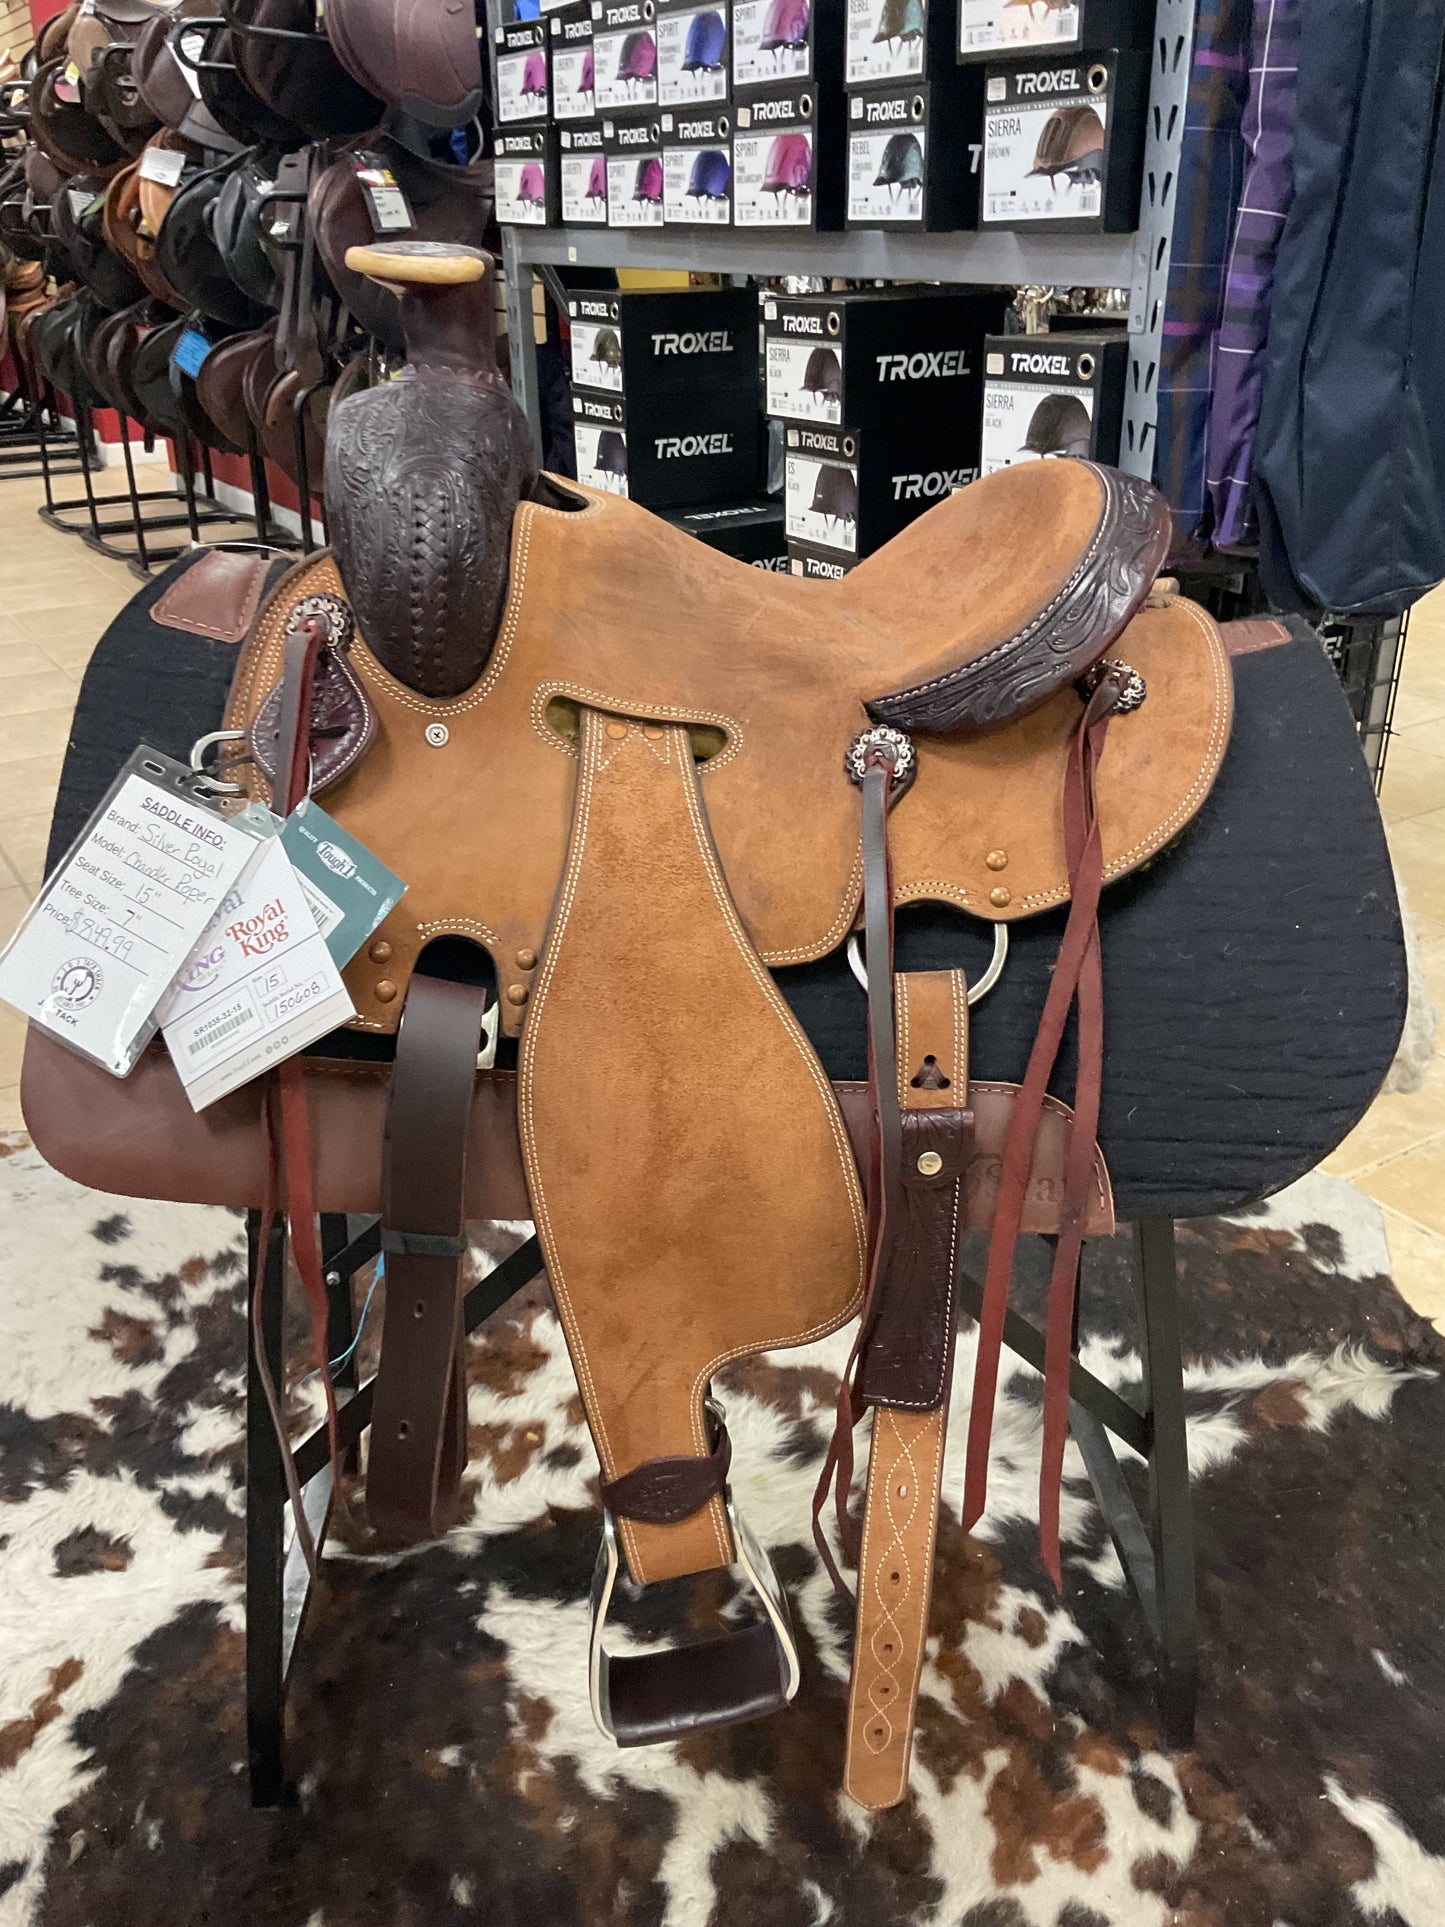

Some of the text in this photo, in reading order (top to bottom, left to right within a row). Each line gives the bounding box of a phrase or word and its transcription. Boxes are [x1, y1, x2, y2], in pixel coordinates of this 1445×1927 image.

[607, 5, 640, 26] TROXEL
[507, 31, 534, 47] TROXEL
[564, 21, 593, 39] TROXEL
[1015, 69, 1081, 95] TROXEL
[752, 101, 796, 120] TROXEL
[866, 100, 907, 122] TROXEL
[618, 128, 649, 144] TROXEL
[678, 121, 715, 139] TROXEL
[988, 117, 1022, 138] SIERRA
[505, 137, 533, 151] TROXEL
[573, 132, 602, 147] TROXEL
[987, 146, 1010, 160] BROWN
[581, 302, 608, 317] TROXEL
[782, 315, 824, 334] TROXEL
[651, 331, 734, 356] TROXEL
[769, 347, 791, 363] SIERRA
[1011, 353, 1070, 375] TROXEL
[876, 350, 971, 382] TROXEL
[584, 402, 613, 420] TROXEL
[986, 394, 1014, 411] SIERRA
[655, 433, 733, 459] TROXEL
[801, 431, 839, 452] TROXEL
[142, 797, 226, 850] SADDLE INFO:
[107, 809, 224, 880] Brand: Silver Royal
[75, 856, 98, 876] Seat
[100, 870, 127, 892] Size:
[90, 833, 124, 858] Model:
[175, 873, 216, 905] Roper
[60, 879, 83, 899] Tree
[83, 893, 111, 915] Size:
[42, 902, 73, 926] Price:
[225, 898, 286, 941] Royal
[239, 920, 289, 958] King
[265, 973, 280, 993] 15
[274, 981, 320, 1019] 150608
[55, 1008, 79, 1027] TACK
